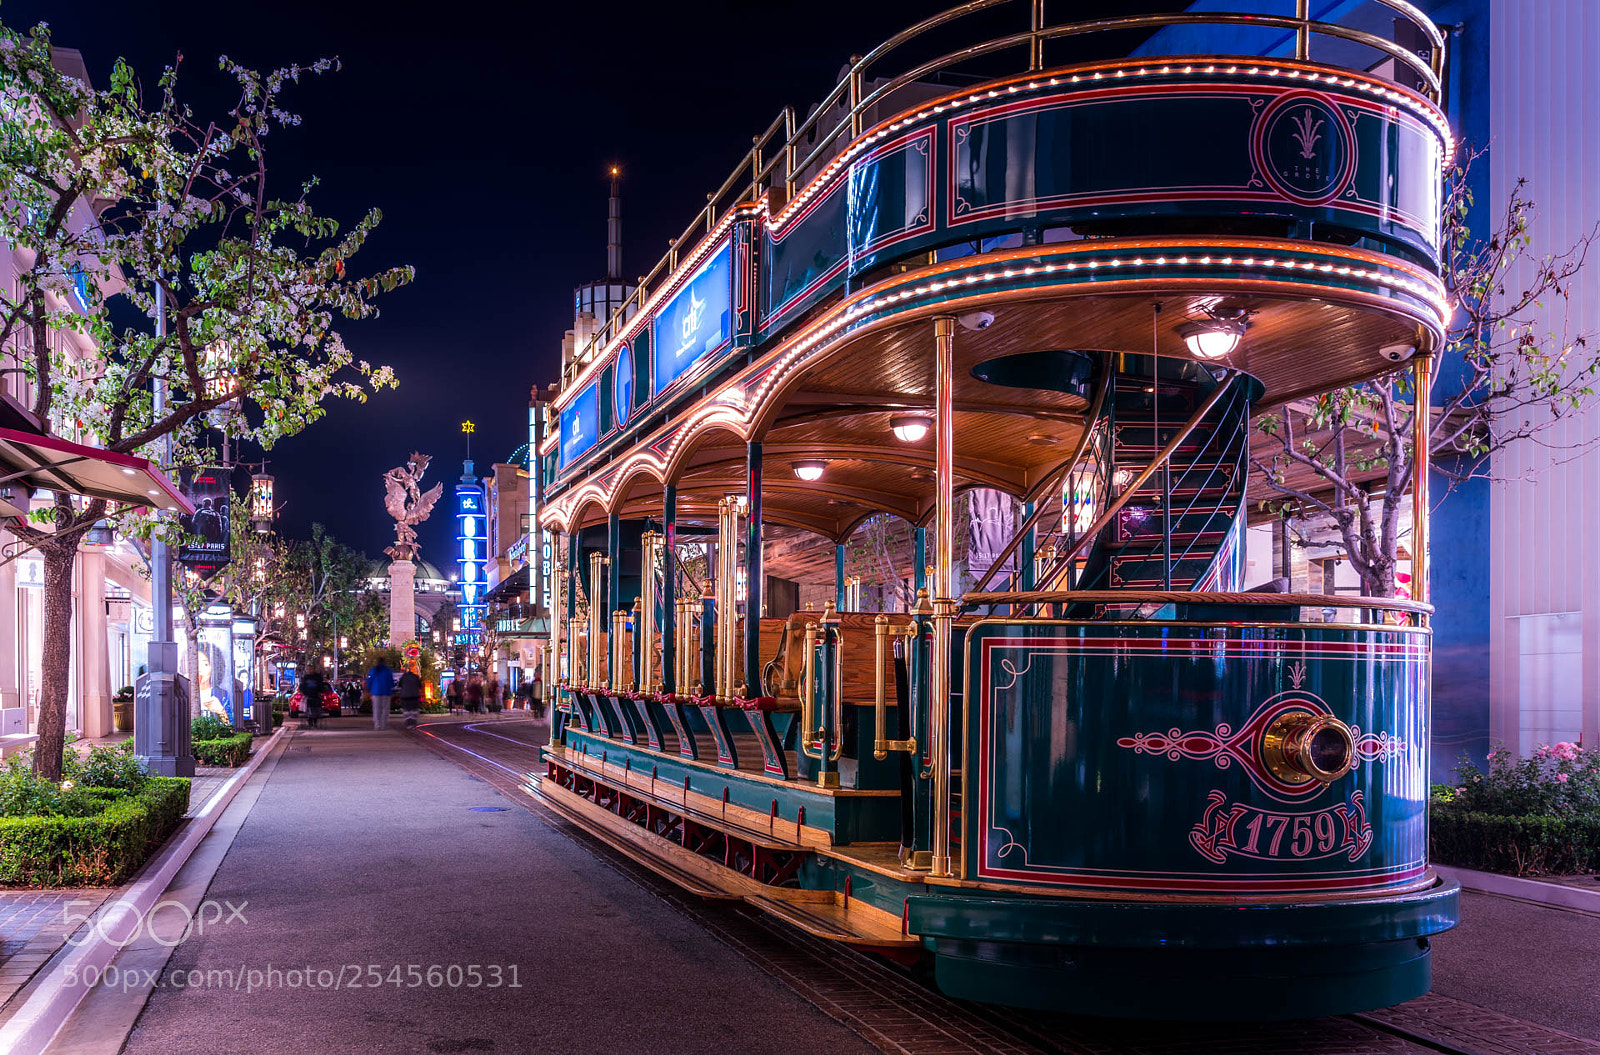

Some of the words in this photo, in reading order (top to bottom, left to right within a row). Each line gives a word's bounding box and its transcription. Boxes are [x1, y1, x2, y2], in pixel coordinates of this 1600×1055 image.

[1283, 171, 1330, 182] GROVE
[1294, 166, 1319, 174] THE
[542, 529, 551, 609] NOBLE
[498, 619, 521, 632] NOBLE
[1241, 812, 1336, 858] 1759
